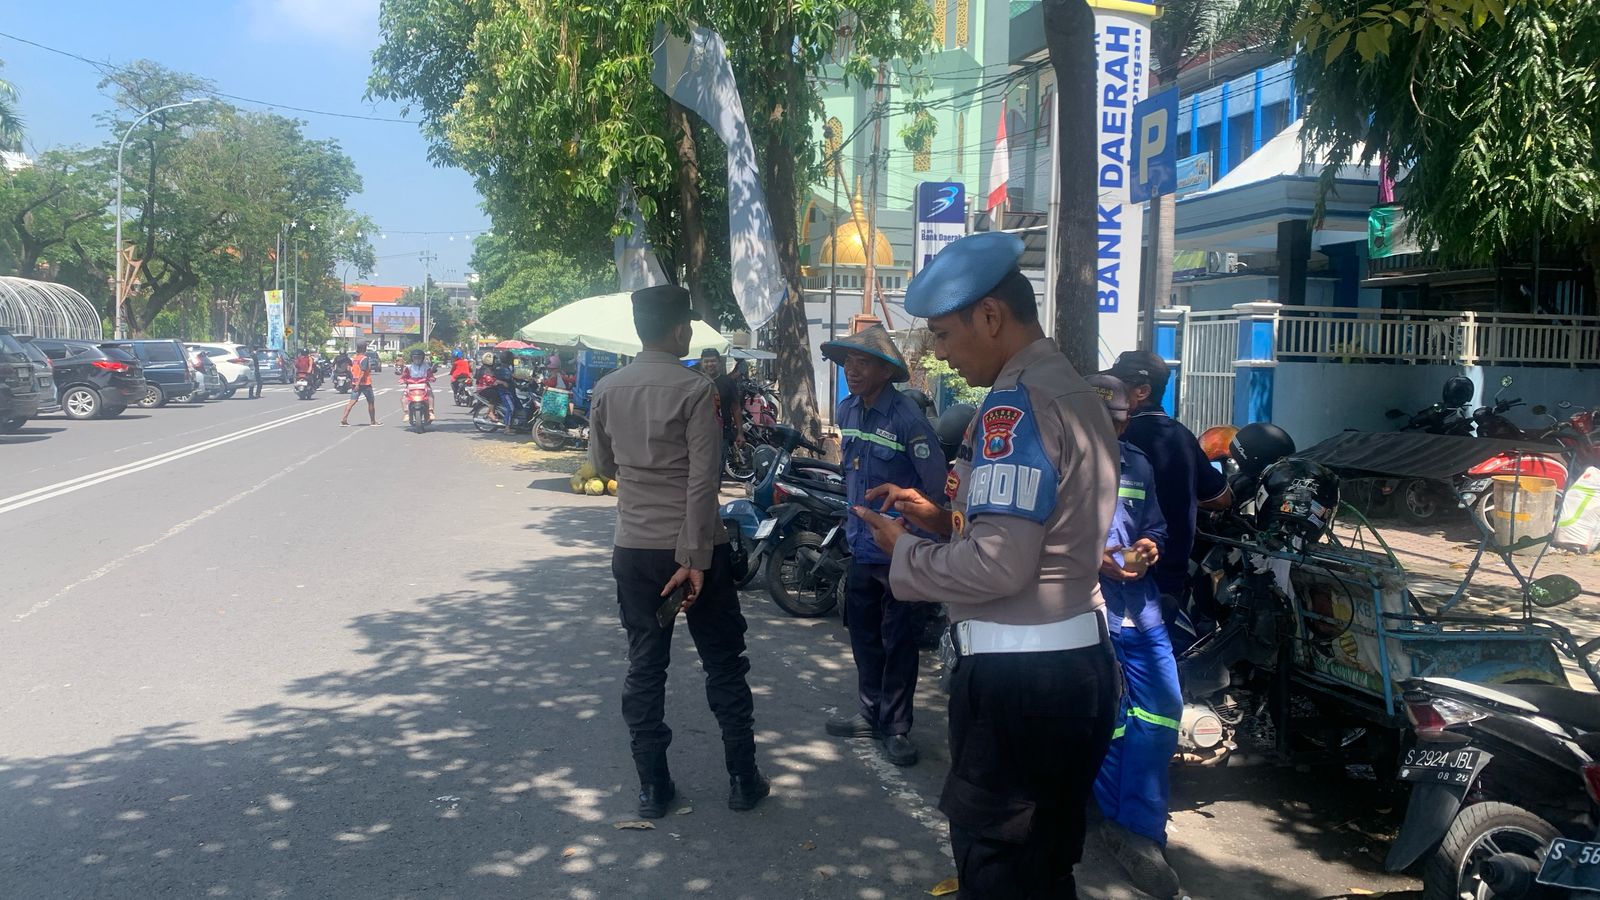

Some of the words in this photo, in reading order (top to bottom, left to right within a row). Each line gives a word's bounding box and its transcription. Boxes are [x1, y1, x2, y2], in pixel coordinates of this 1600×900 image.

[1100, 26, 1130, 188] DAERAH
[1139, 108, 1168, 185] P
[921, 233, 937, 241] Bank
[1097, 204, 1122, 313] BANK
[1405, 749, 1416, 765] S
[1415, 750, 1450, 768] 2924
[1450, 752, 1473, 770] JBL
[1437, 771, 1450, 781] 08
[1551, 842, 1566, 860] S
